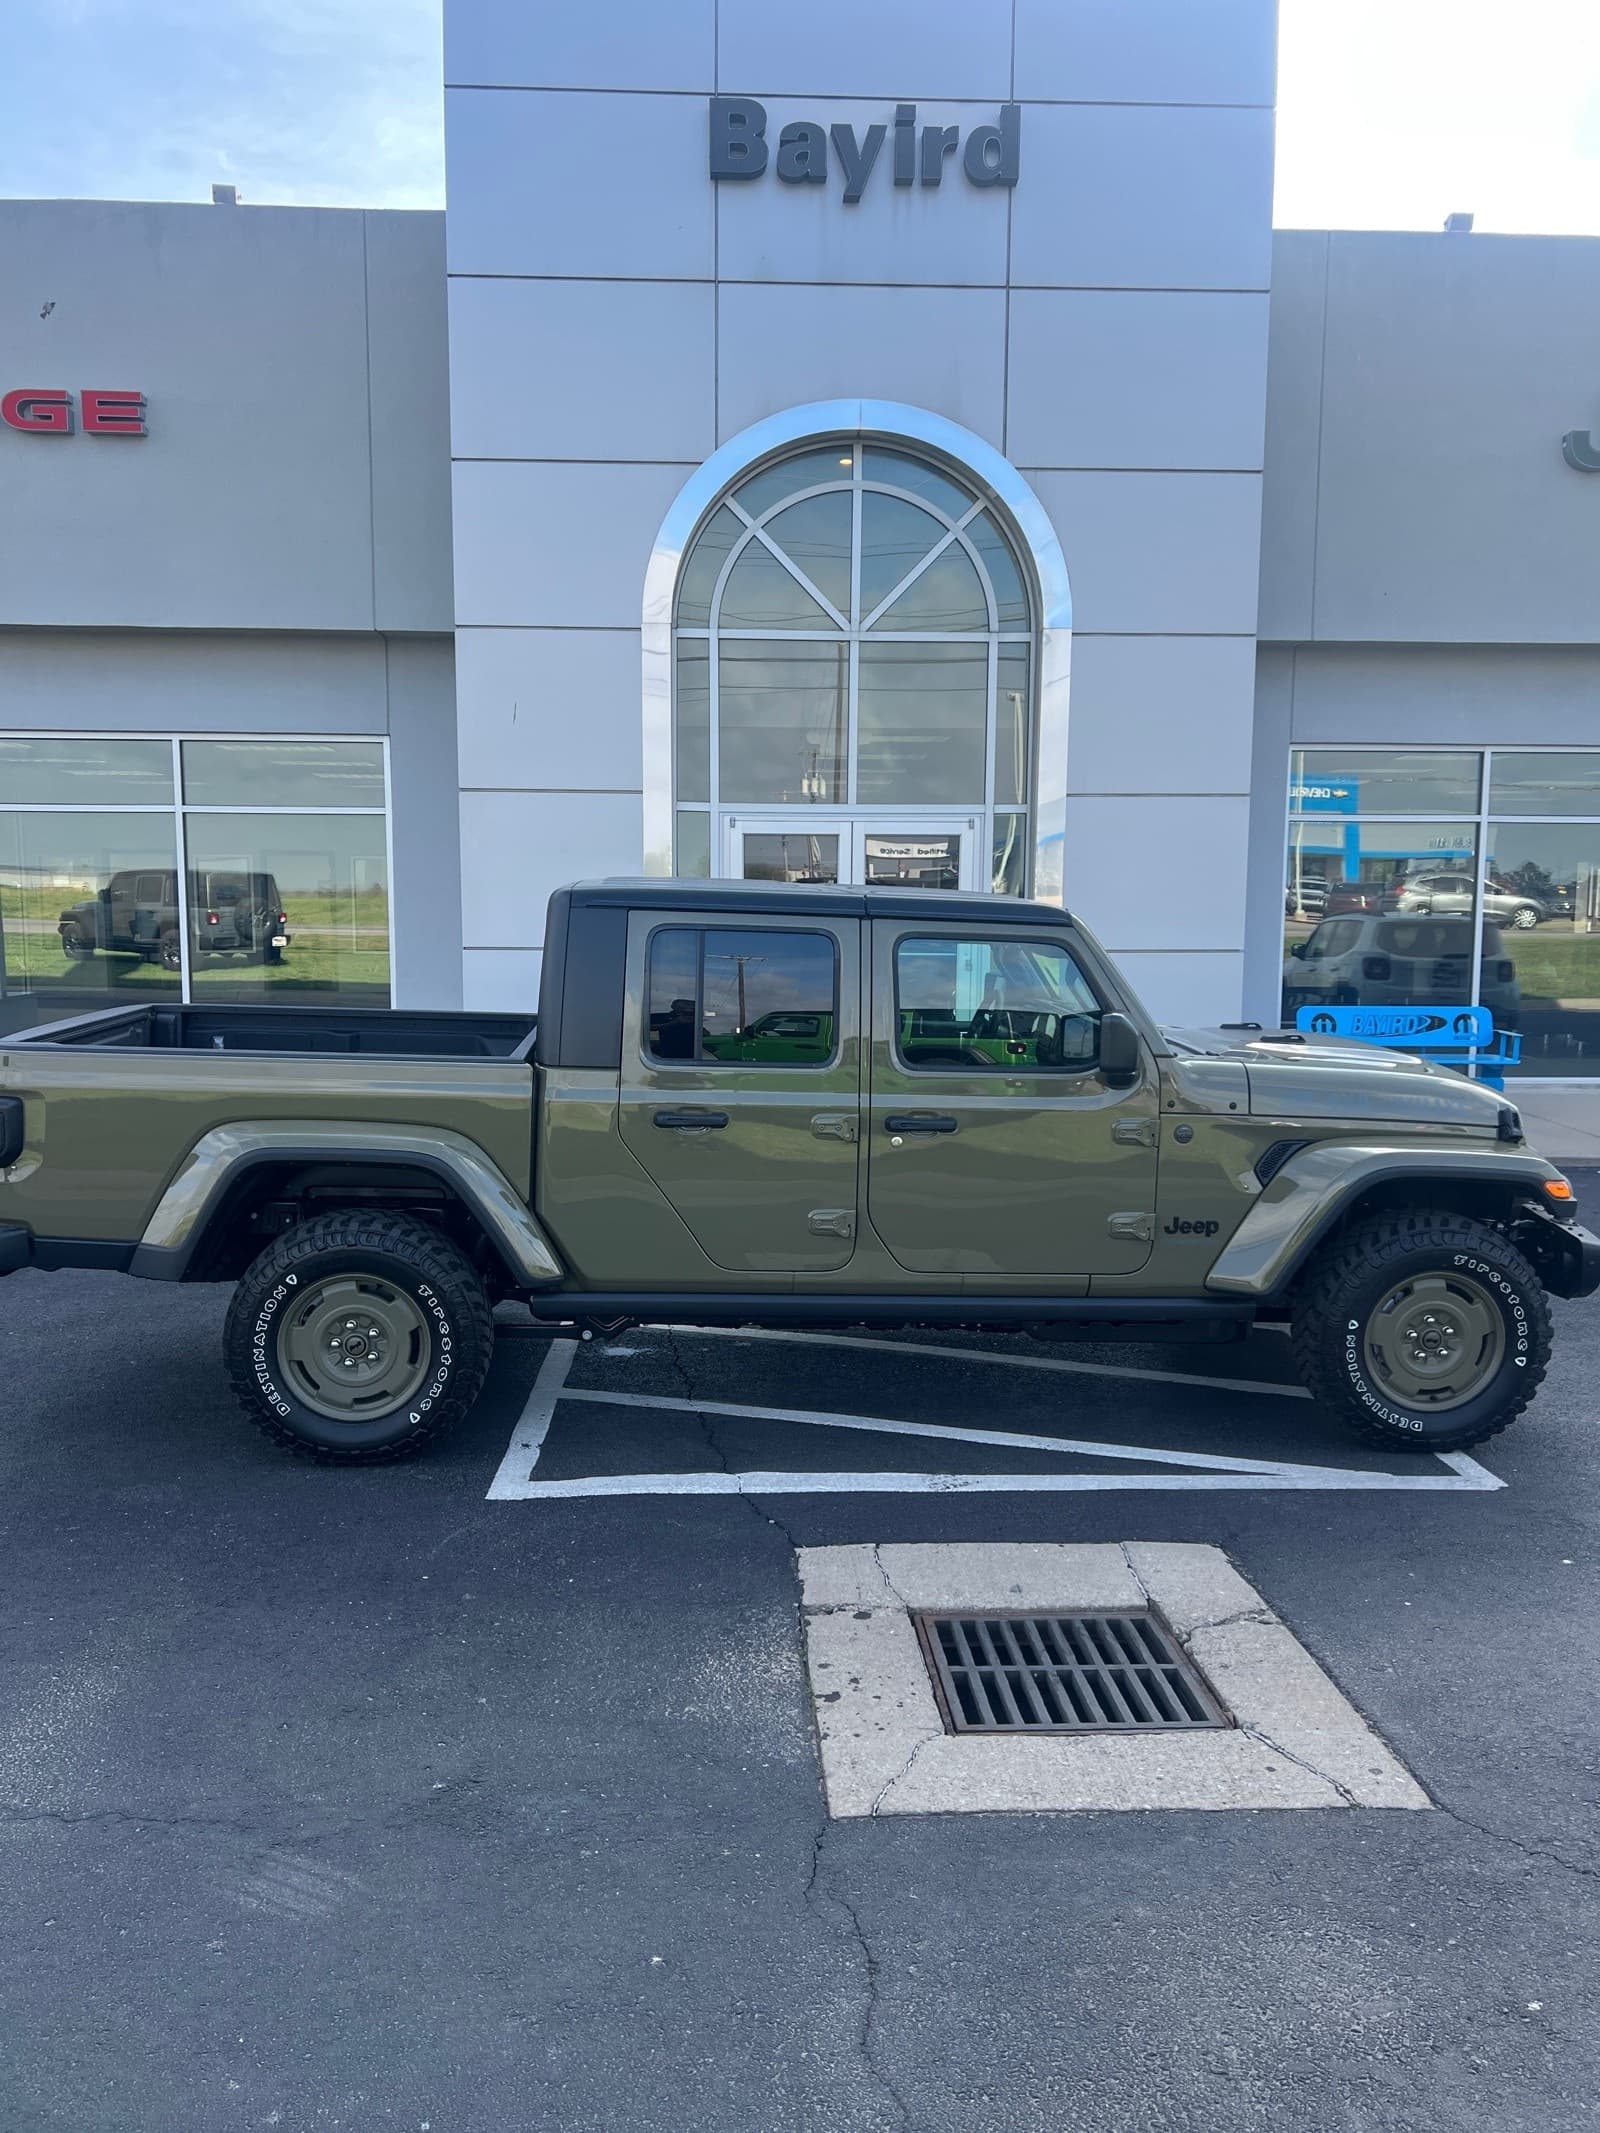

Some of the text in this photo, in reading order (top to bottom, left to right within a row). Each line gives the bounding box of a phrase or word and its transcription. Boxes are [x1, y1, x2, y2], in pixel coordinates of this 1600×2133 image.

[709, 97, 1021, 203] Bayird
[1351, 1014, 1418, 1034] BAYIRD
[1163, 1216, 1219, 1238] Jeep
[253, 1285, 292, 1417] DESTINATION
[1345, 1335, 1424, 1432] DESTINATION
